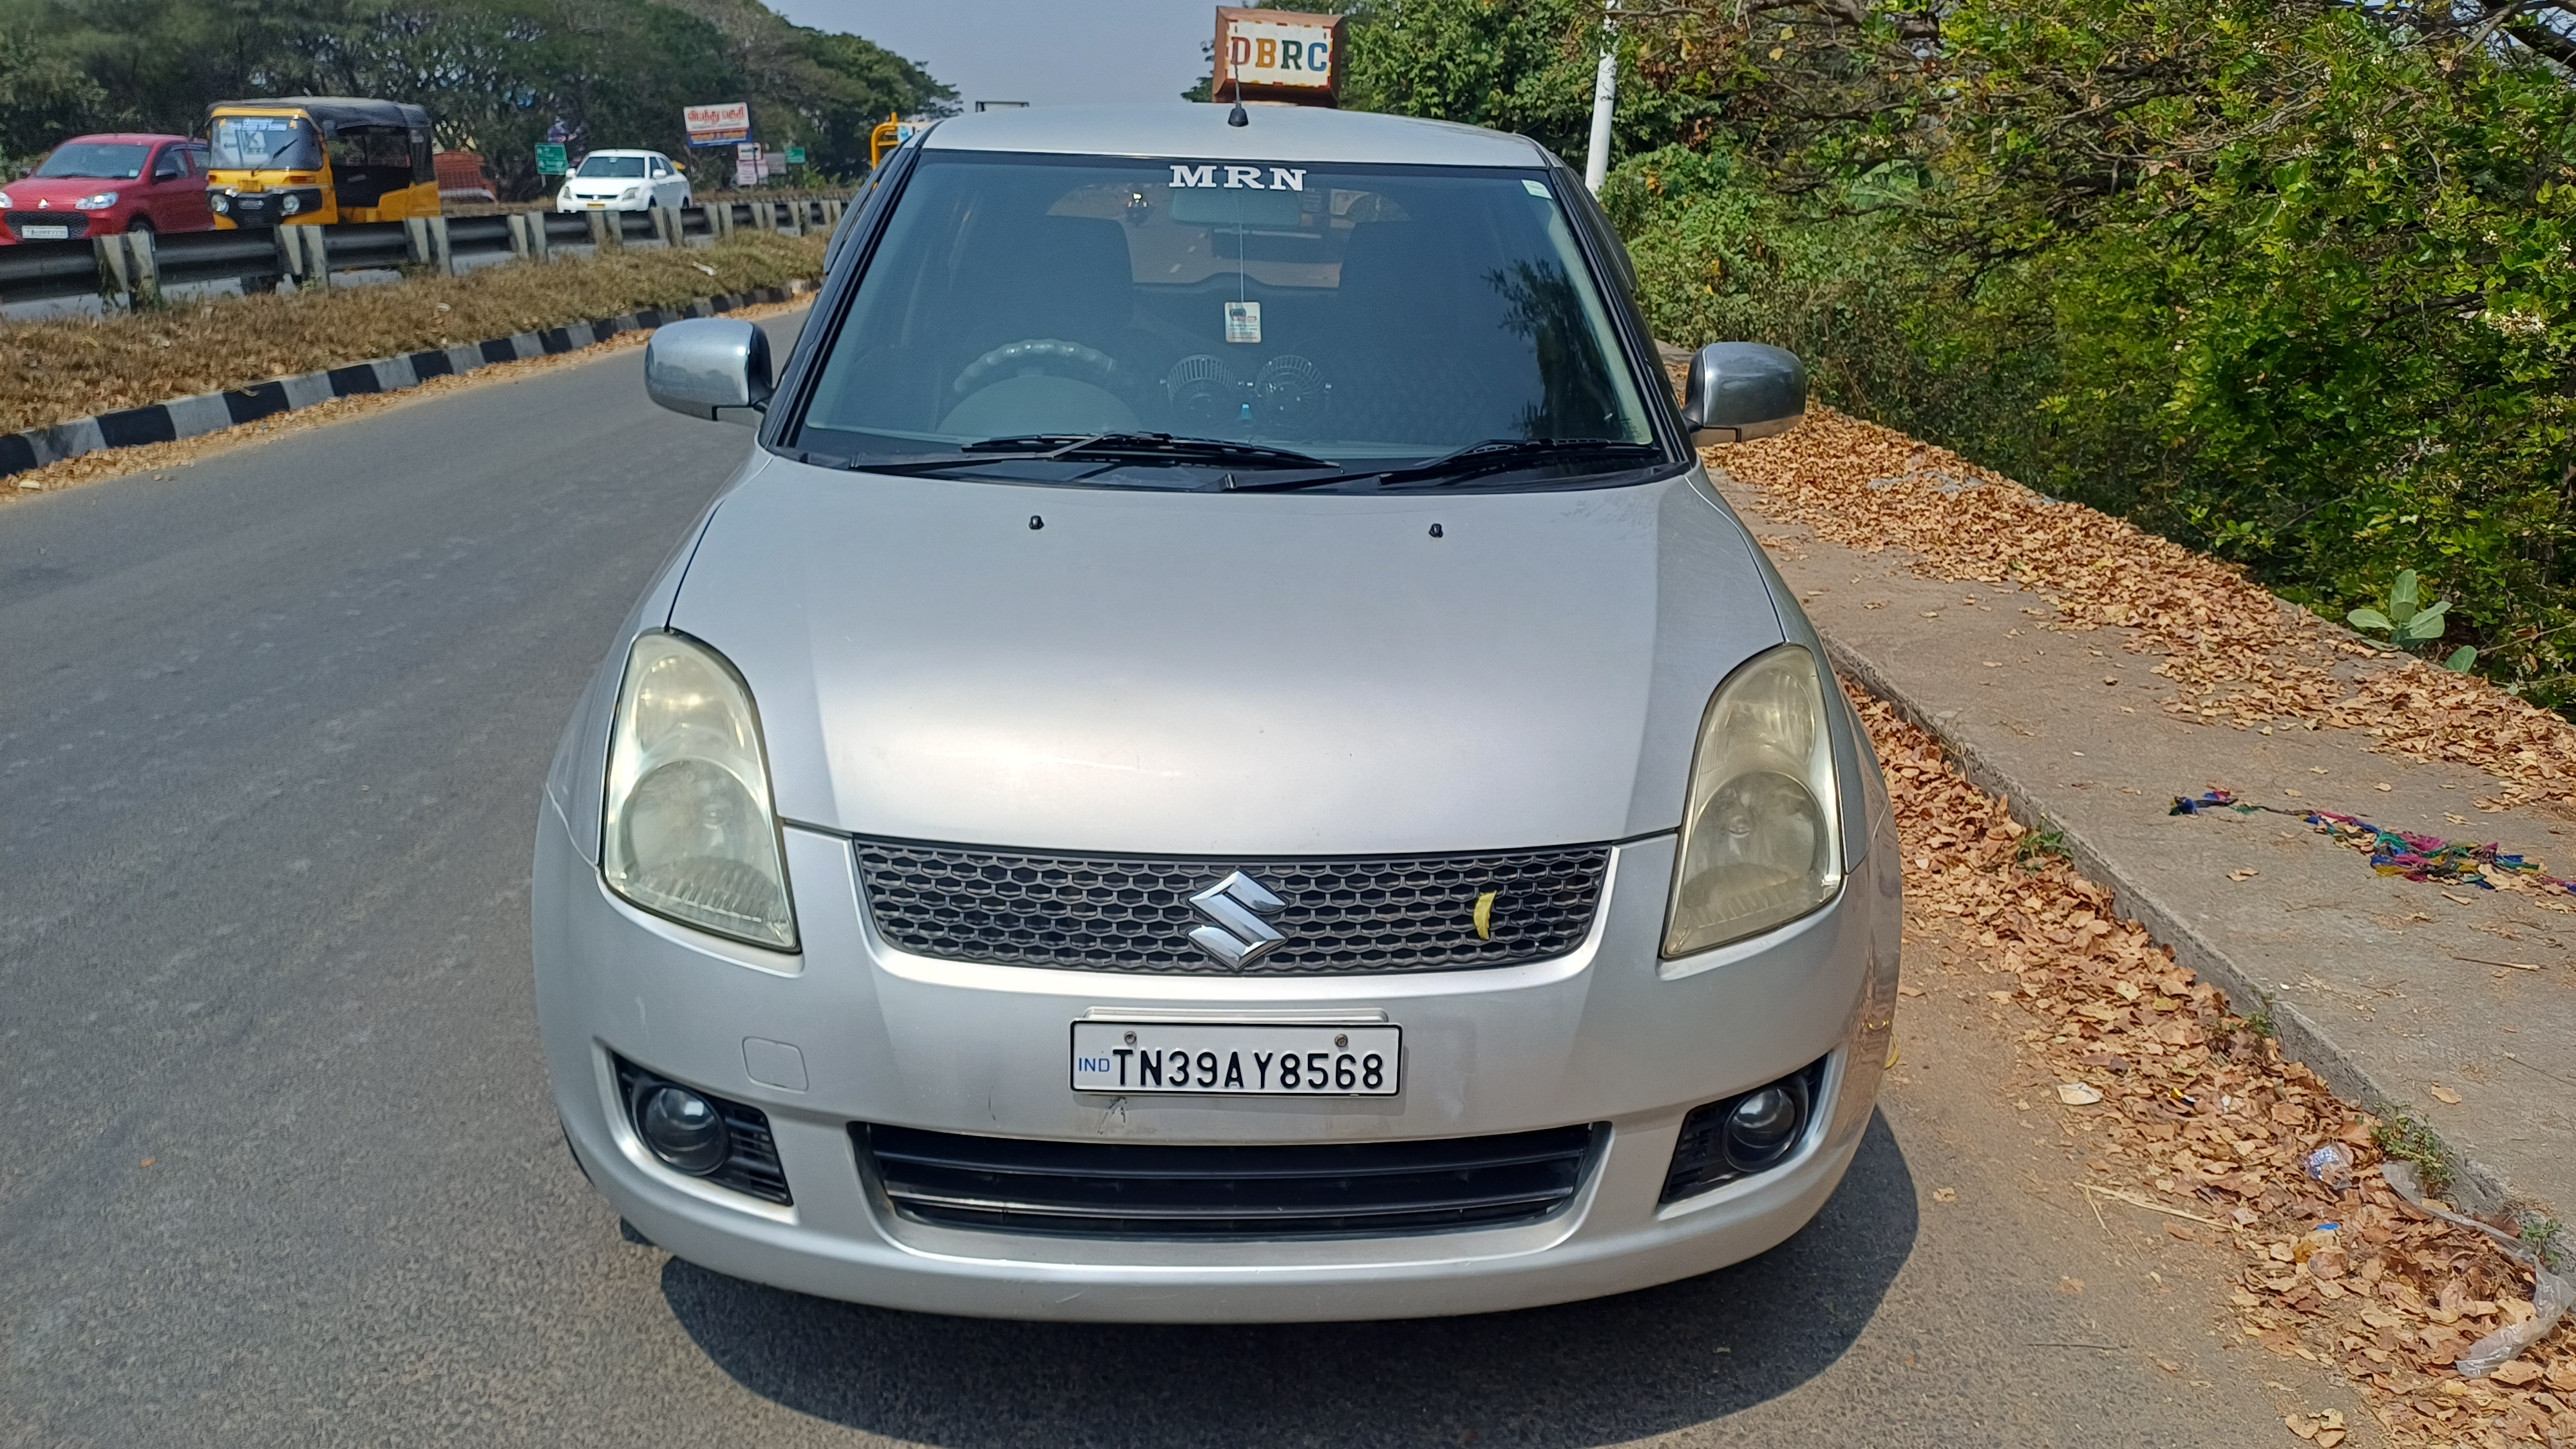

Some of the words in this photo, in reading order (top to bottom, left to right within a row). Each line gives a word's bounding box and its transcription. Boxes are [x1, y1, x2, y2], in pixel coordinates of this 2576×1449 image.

[1229, 36, 1328, 72] DBRC
[1168, 165, 1307, 192] MRN
[1079, 1057, 1110, 1072] IND
[1112, 1048, 1384, 1090] TN39AY8568
